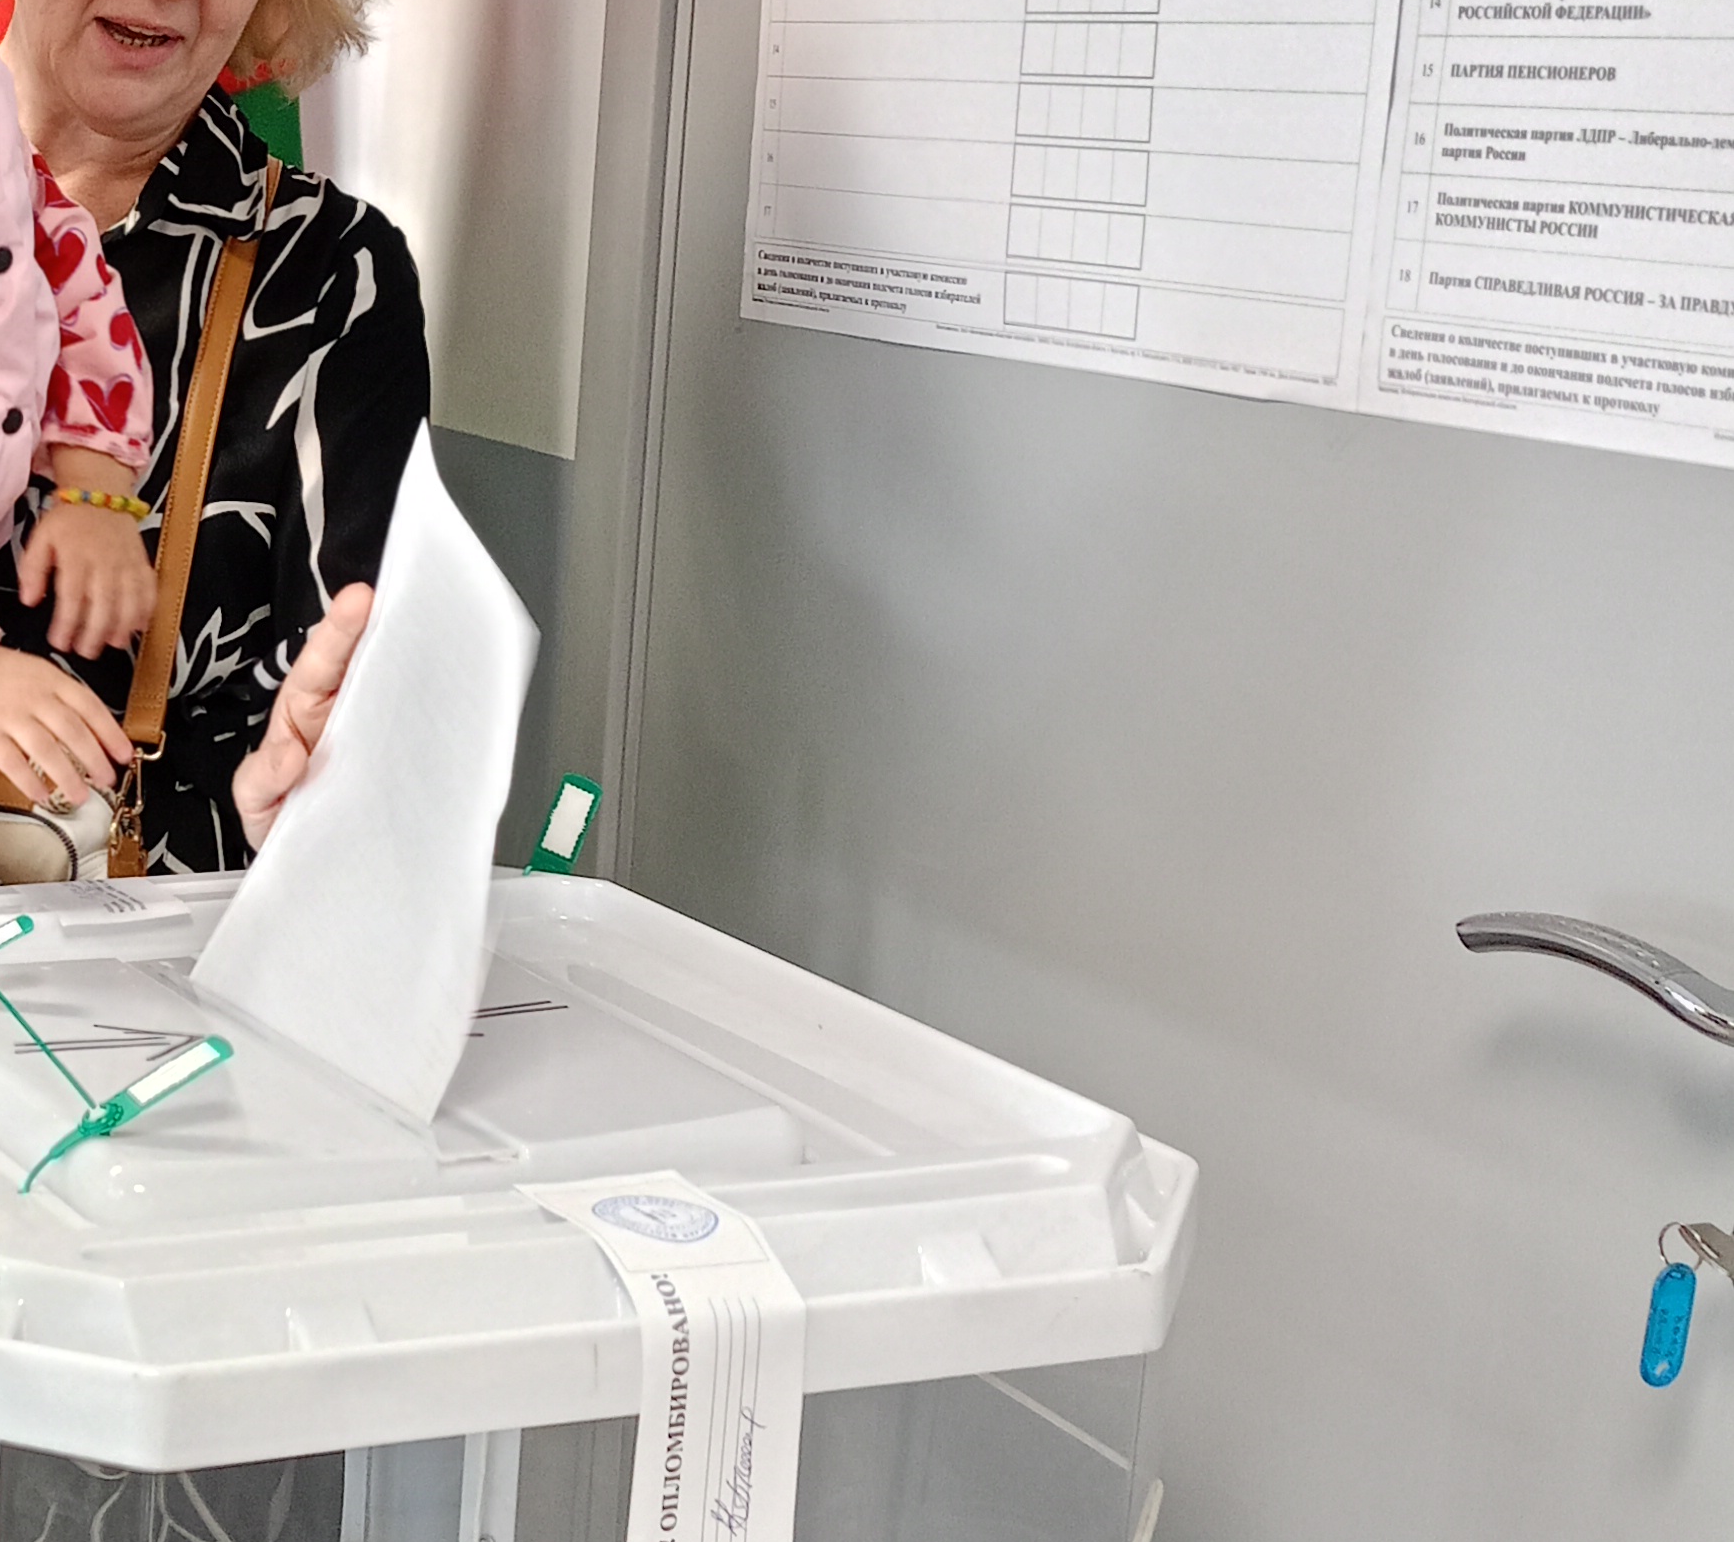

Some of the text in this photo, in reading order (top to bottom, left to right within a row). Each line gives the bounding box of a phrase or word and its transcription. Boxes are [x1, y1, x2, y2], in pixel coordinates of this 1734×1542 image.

[1457, 2, 1652, 21] РОССИЙСКОЙ ФЕДЕРАЦИИ»
[1421, 64, 1434, 78] 15
[1450, 63, 1617, 82] ПАРТИЯ ПЕНСИОНЕРОВ
[1414, 132, 1426, 147] 16
[1443, 122, 1528, 140] Политическая
[1530, 130, 1575, 145] партия
[1576, 128, 1617, 145] ЛДПР
[1441, 145, 1526, 162] партия России
[1406, 200, 1419, 215] 17
[1437, 191, 1520, 211] Политическая
[1522, 201, 1566, 216] партия
[1435, 212, 1599, 239] КОММУНИСТЫ РОССИИ
[1398, 268, 1411, 283] 18
[1429, 271, 1472, 290] Партия
[1474, 275, 1581, 300] СПРАВЕДЛИВАЯ
[1583, 286, 1645, 307] РОССИЯ
[1659, 293, 1677, 310] ЗА
[650, 1273, 690, 1532] ОПЛОМБИРОВАНО!
